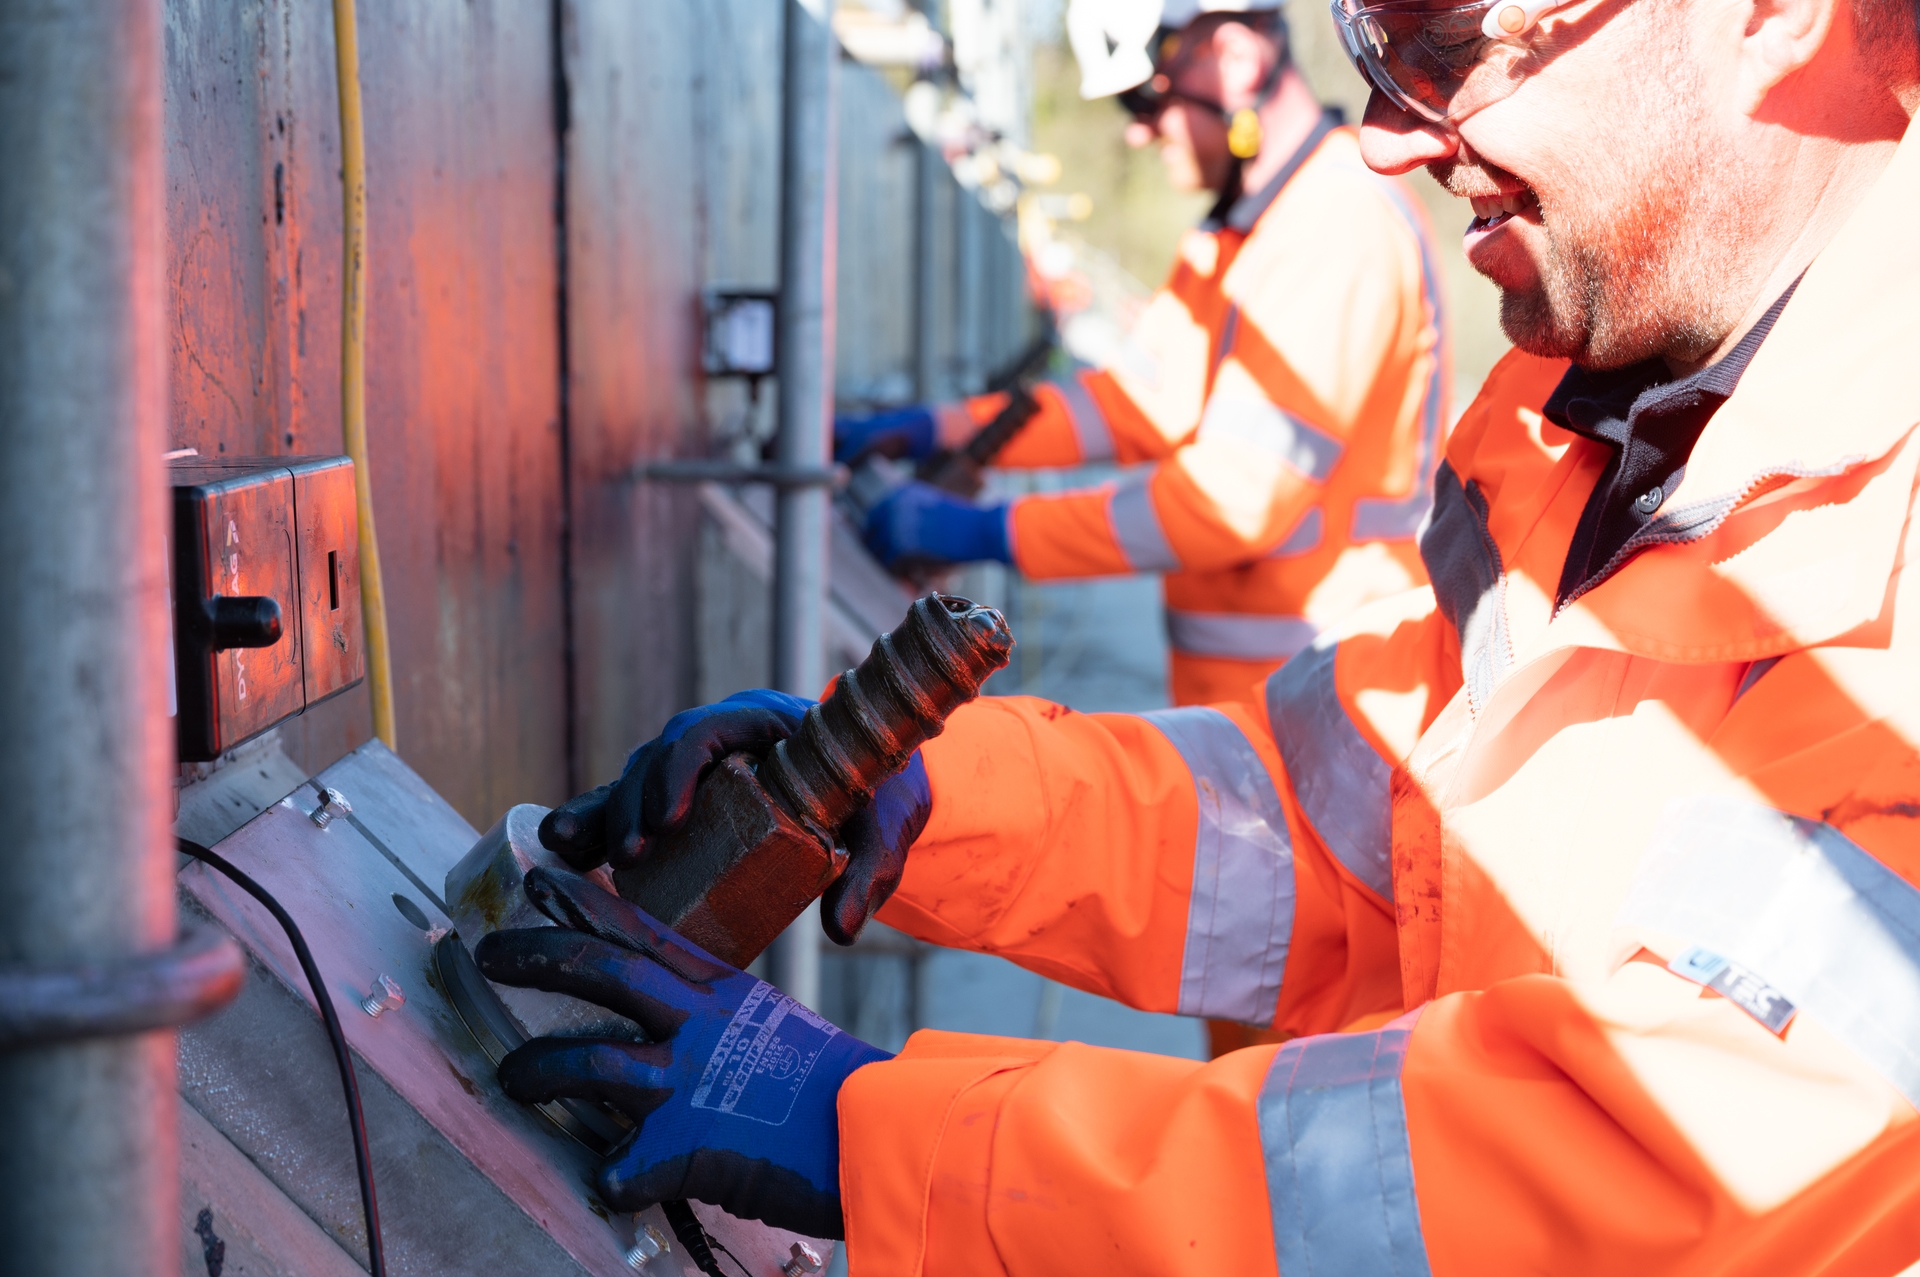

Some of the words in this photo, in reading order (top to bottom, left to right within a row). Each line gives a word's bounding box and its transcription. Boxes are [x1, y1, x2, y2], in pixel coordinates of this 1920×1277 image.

[229, 553, 246, 700] DYNAG
[729, 1037, 750, 1065] 10
[765, 992, 783, 1005] XL
[766, 1044, 785, 1071] 2016
